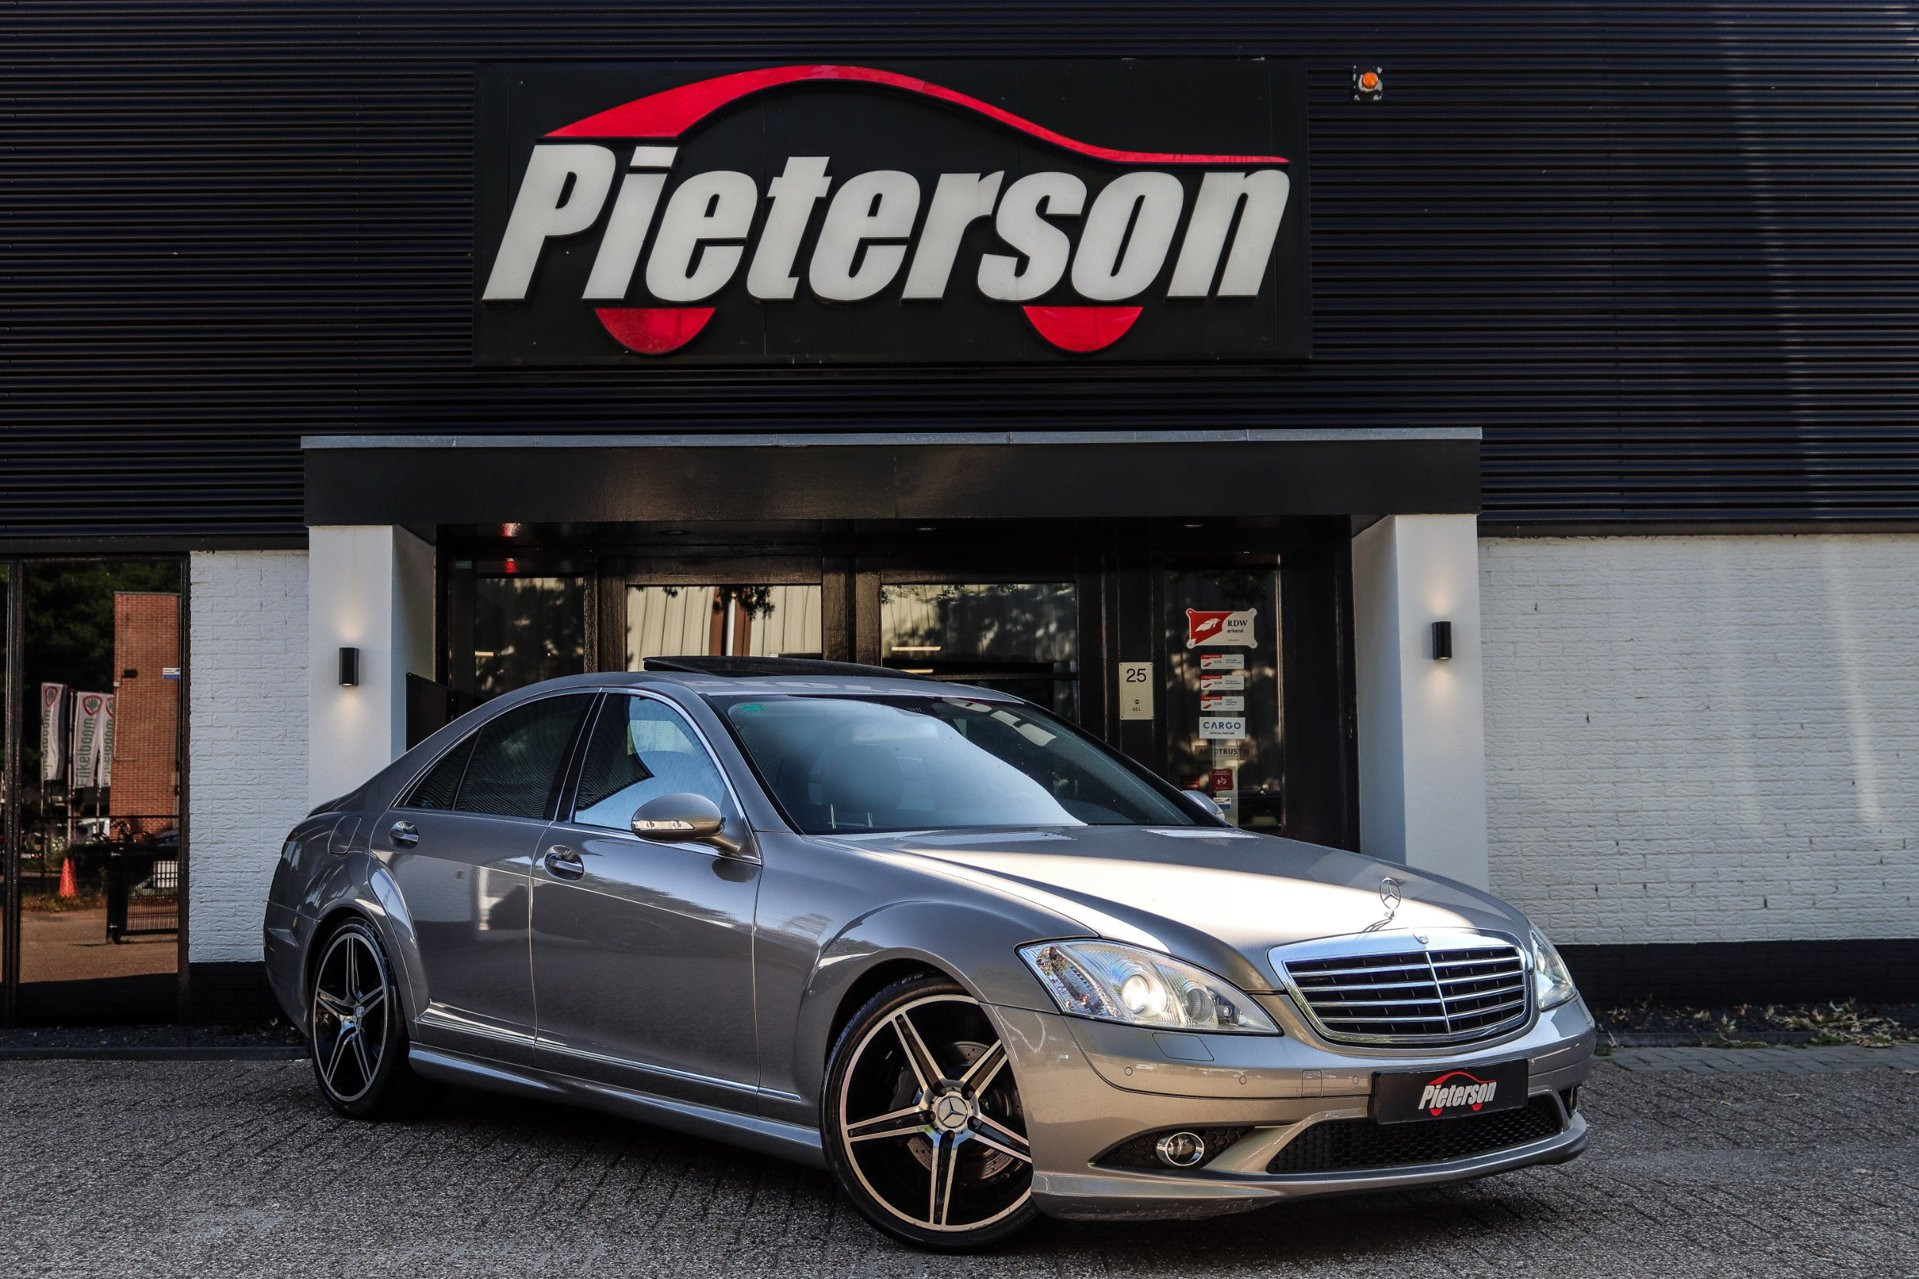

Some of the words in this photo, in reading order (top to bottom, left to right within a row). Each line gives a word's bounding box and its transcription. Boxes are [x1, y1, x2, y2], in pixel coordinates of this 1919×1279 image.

[482, 144, 1290, 302] Pieterson
[1227, 619, 1248, 627] RDW
[1126, 668, 1147, 683] 25
[1203, 721, 1242, 730] CARGO
[1418, 1081, 1497, 1110] Pieterson
